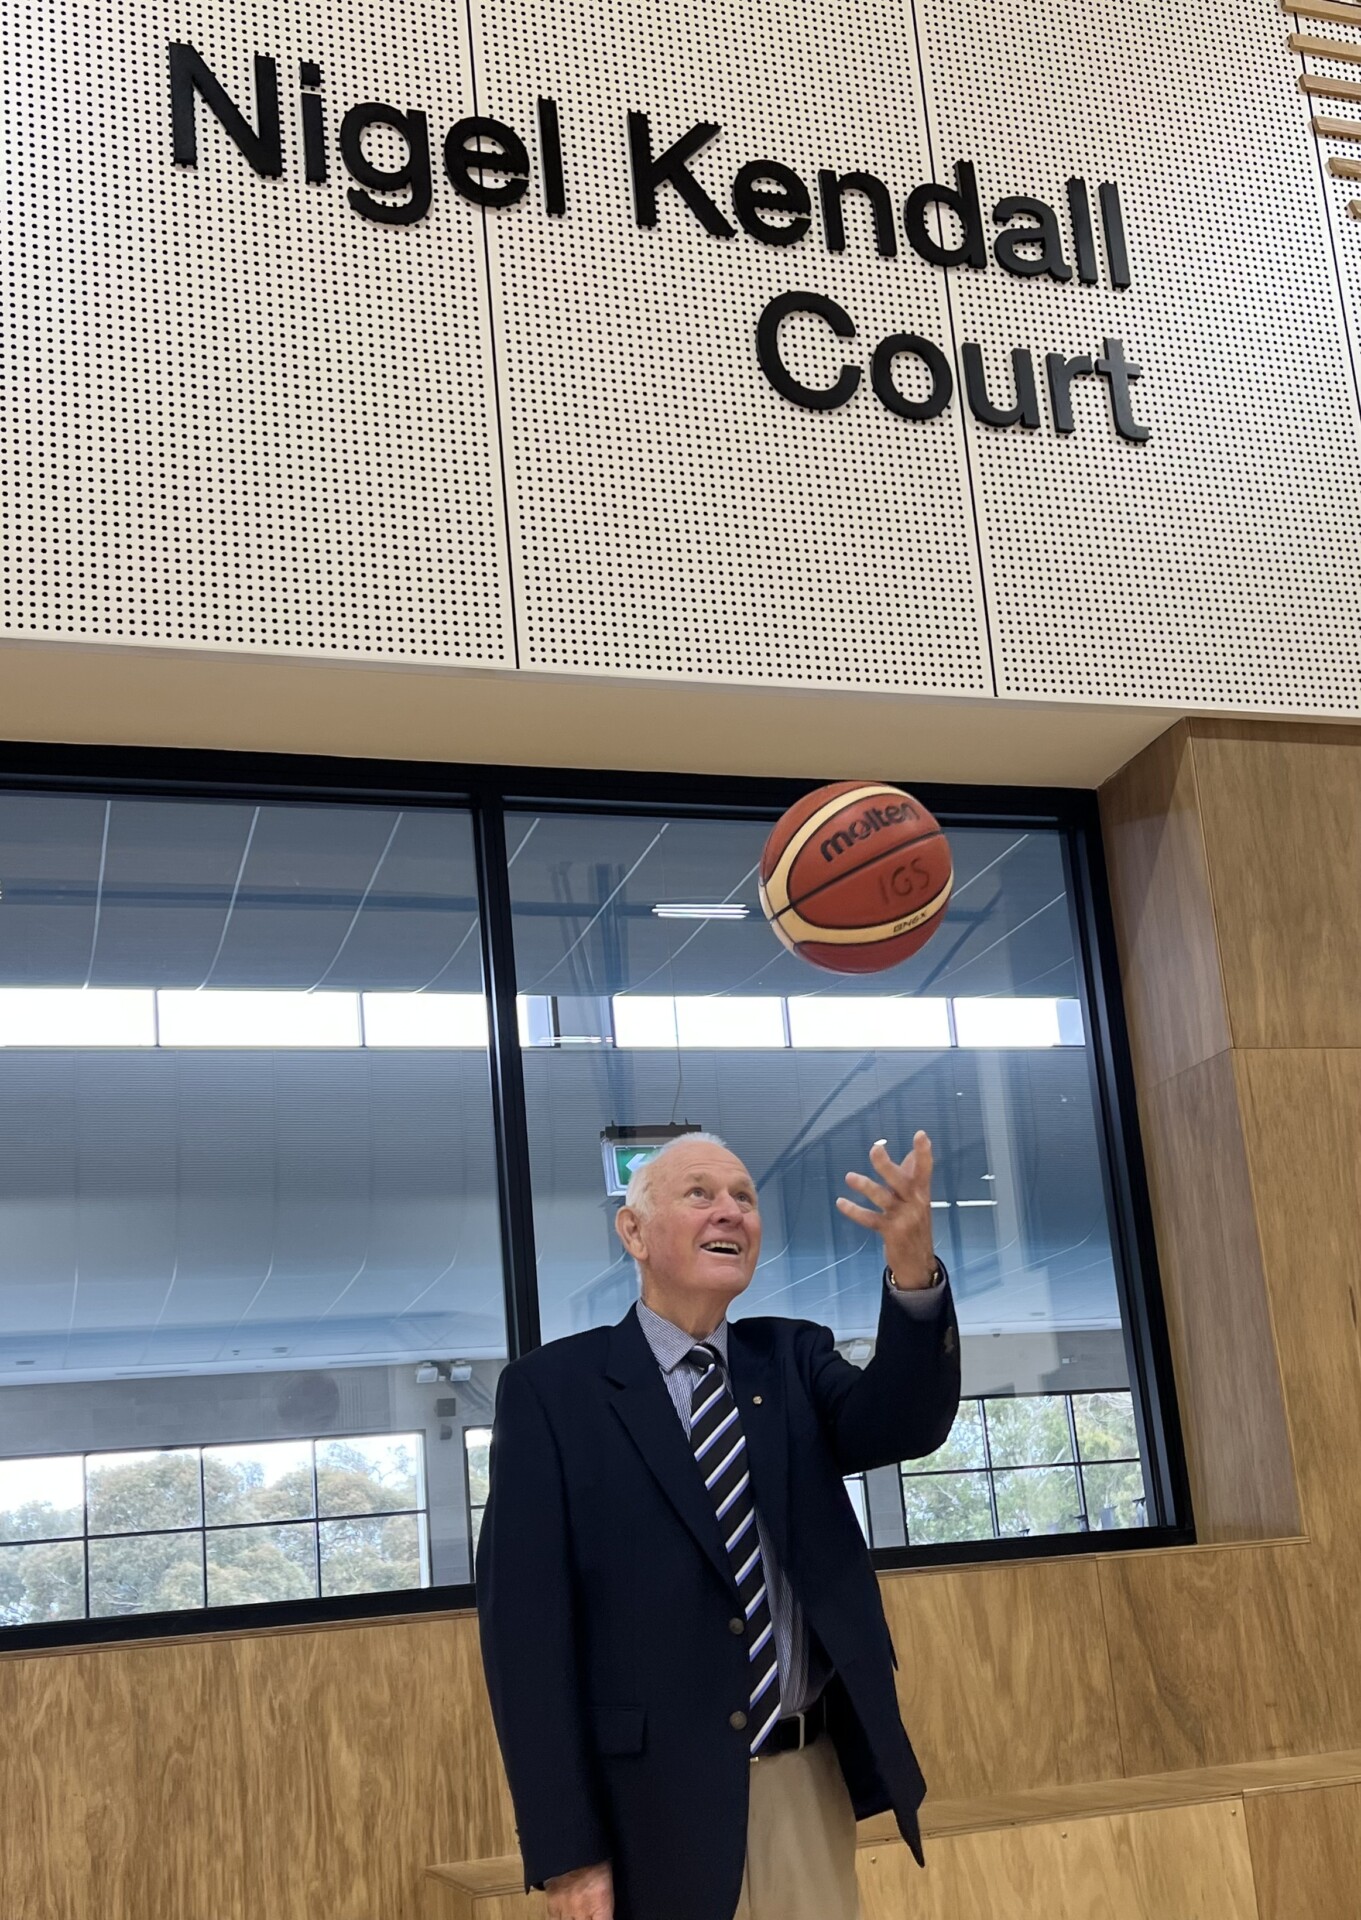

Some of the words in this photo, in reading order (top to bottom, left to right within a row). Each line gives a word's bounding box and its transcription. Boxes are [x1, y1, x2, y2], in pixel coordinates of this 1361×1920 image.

[168, 41, 566, 226] Nigel
[627, 109, 1132, 290] Kendall
[755, 289, 1150, 442] Court
[819, 802, 920, 863] molten
